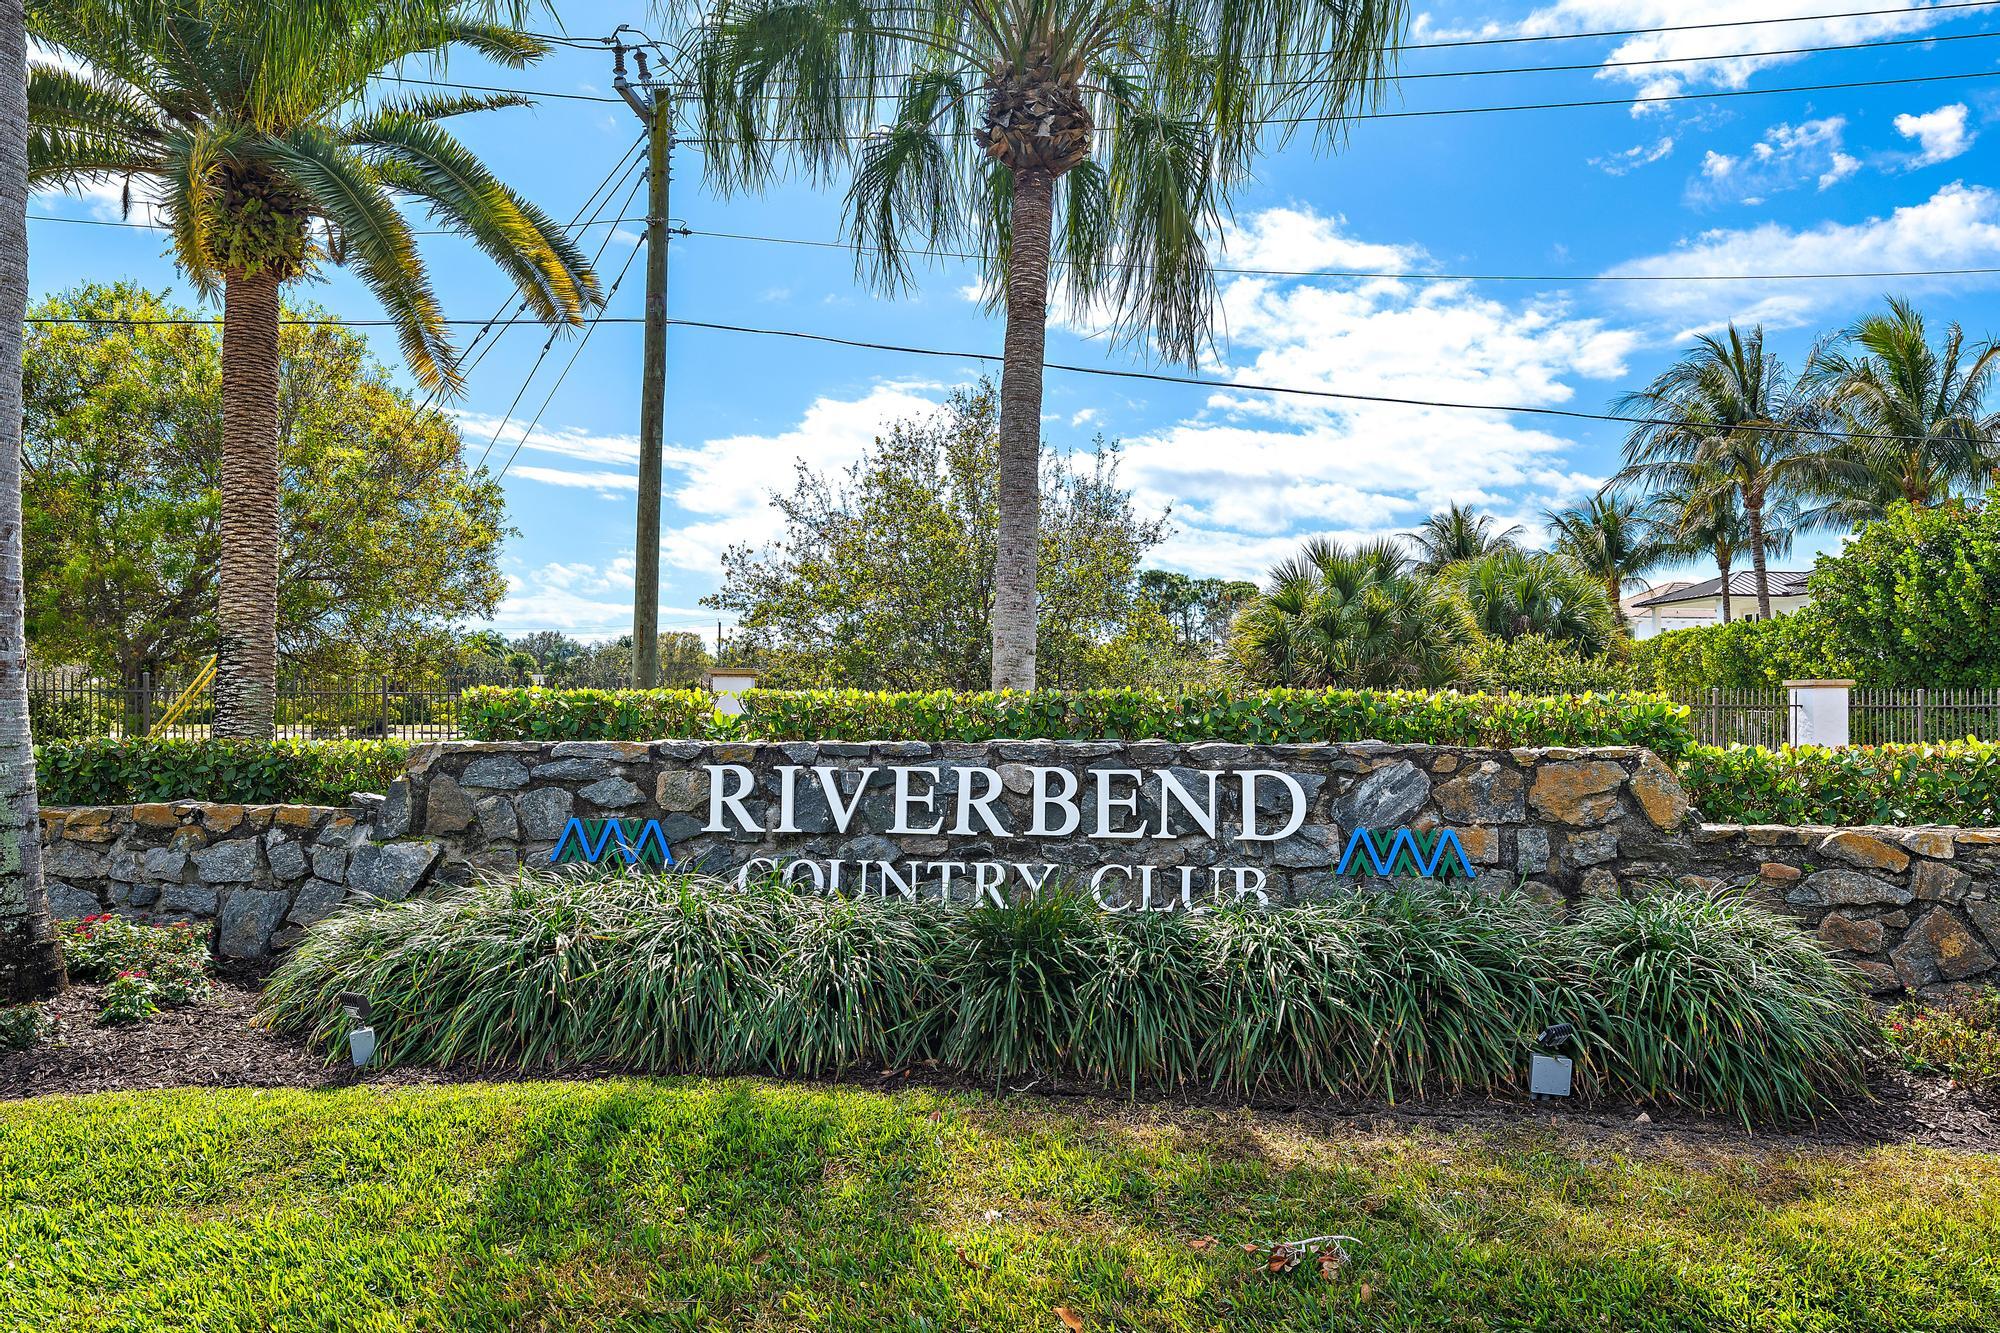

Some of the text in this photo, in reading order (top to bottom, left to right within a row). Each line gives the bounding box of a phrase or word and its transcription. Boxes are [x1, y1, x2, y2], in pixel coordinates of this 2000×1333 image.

[700, 765, 1307, 841] RIVERBEND
[738, 858, 1268, 913] COUNTRY CLUB
